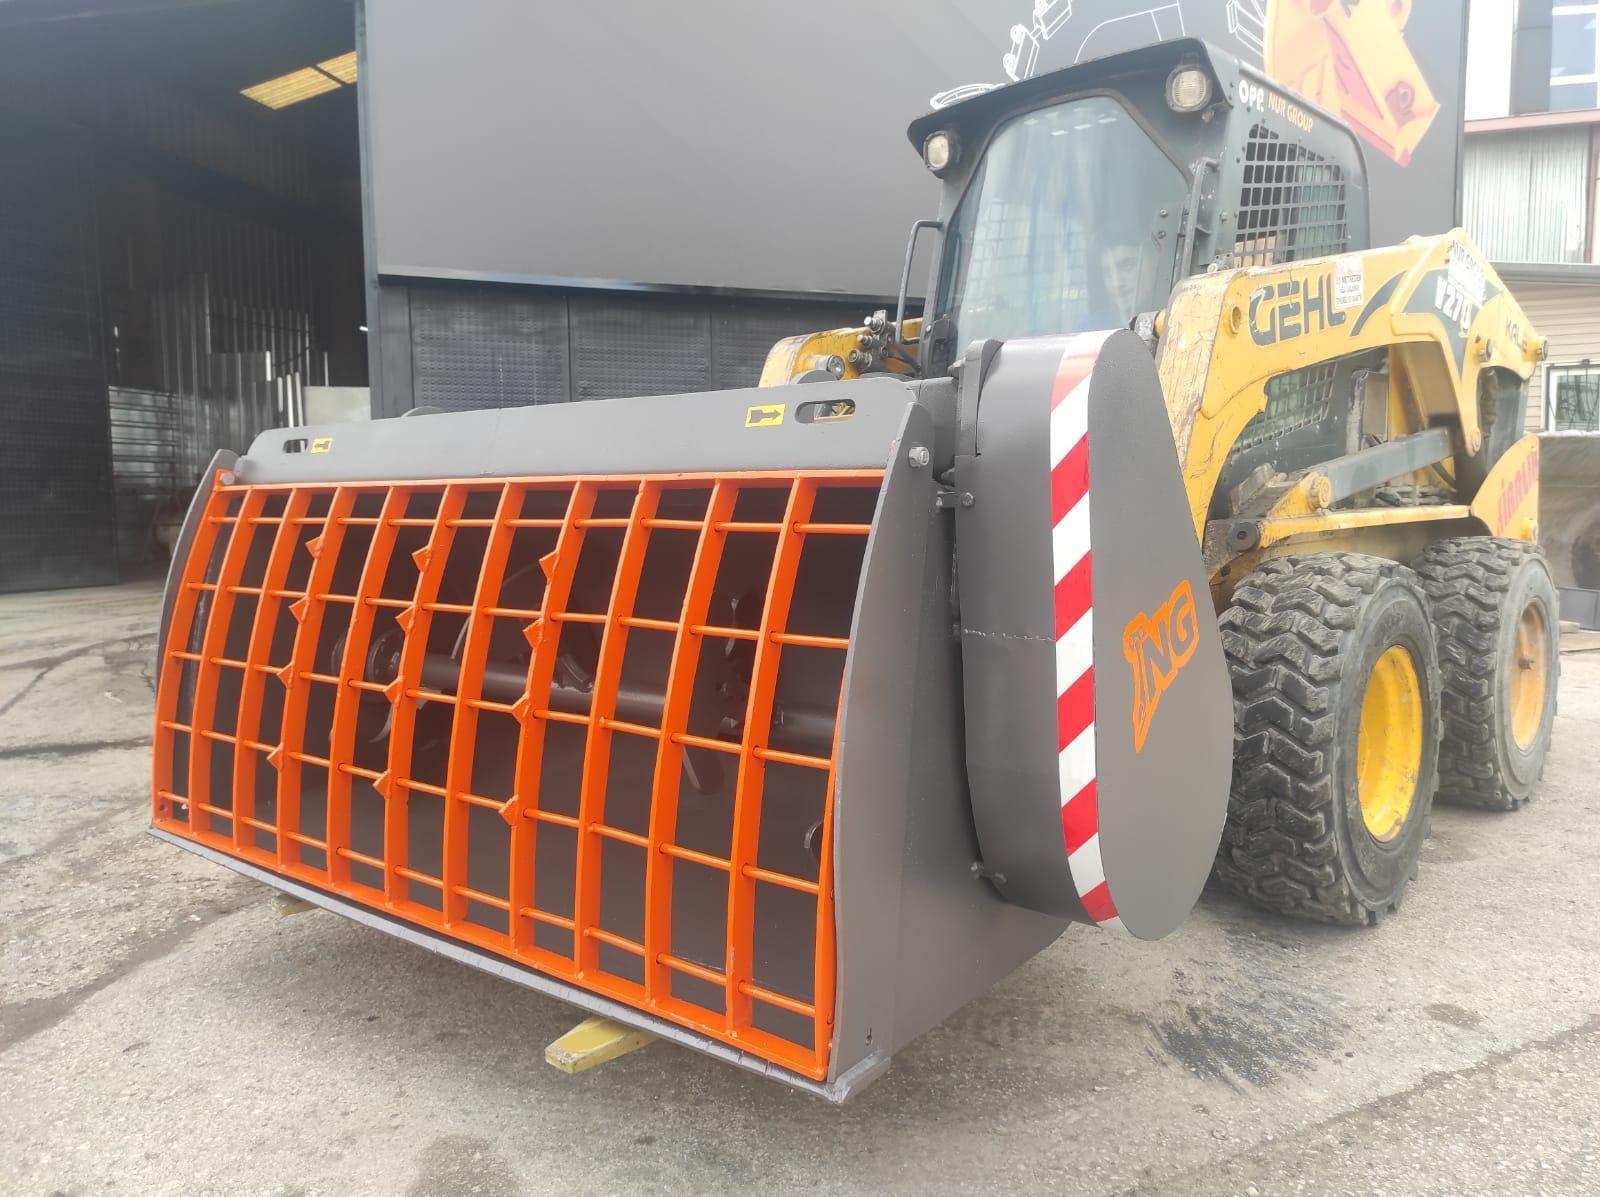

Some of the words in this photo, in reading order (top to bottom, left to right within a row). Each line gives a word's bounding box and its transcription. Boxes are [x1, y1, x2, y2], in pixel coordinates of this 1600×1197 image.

[1268, 92, 1286, 117] NUR
[1287, 104, 1314, 133] GROUP
[1249, 273, 1346, 346] GEHL
